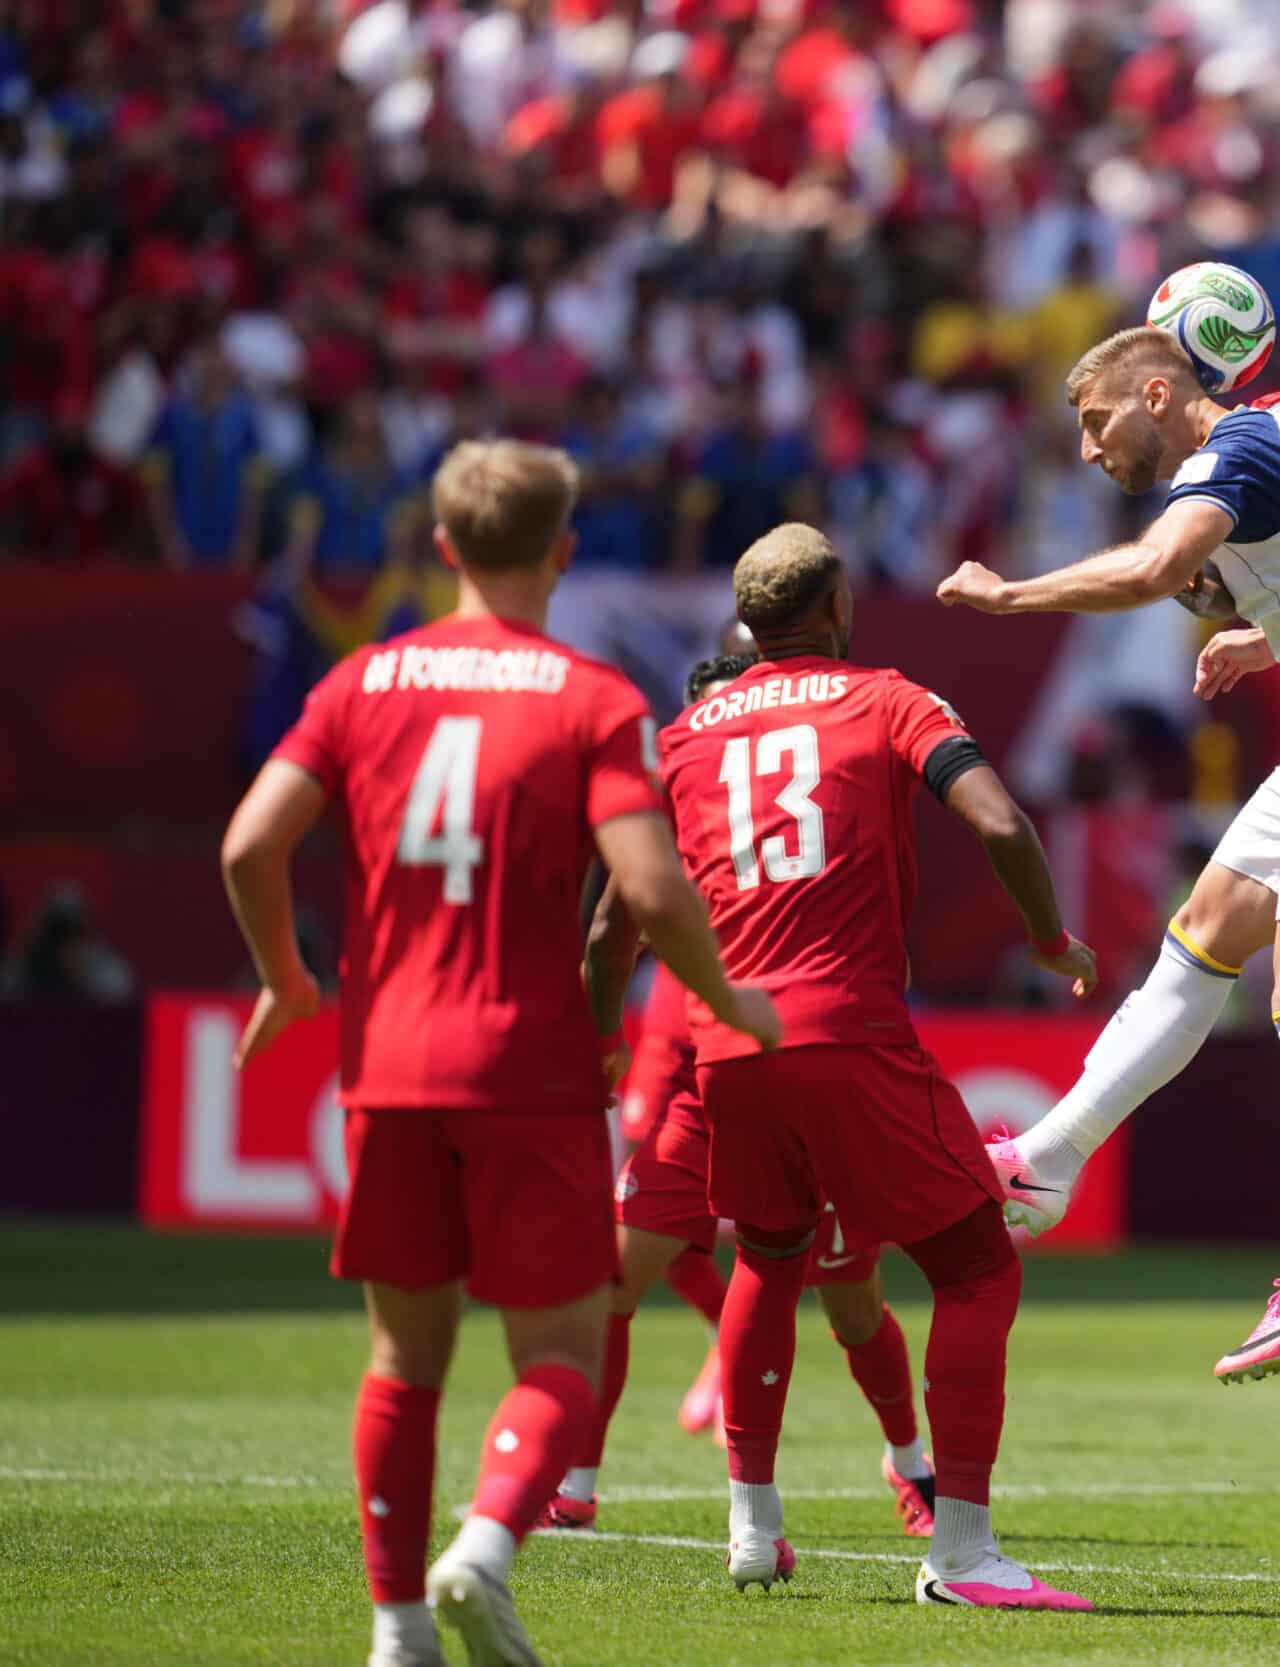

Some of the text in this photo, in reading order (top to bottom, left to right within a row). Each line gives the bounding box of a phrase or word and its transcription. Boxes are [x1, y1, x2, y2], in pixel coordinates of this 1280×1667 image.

[689, 674, 848, 730] CORNELIUS
[398, 715, 483, 905] 4
[718, 723, 826, 892] 13
